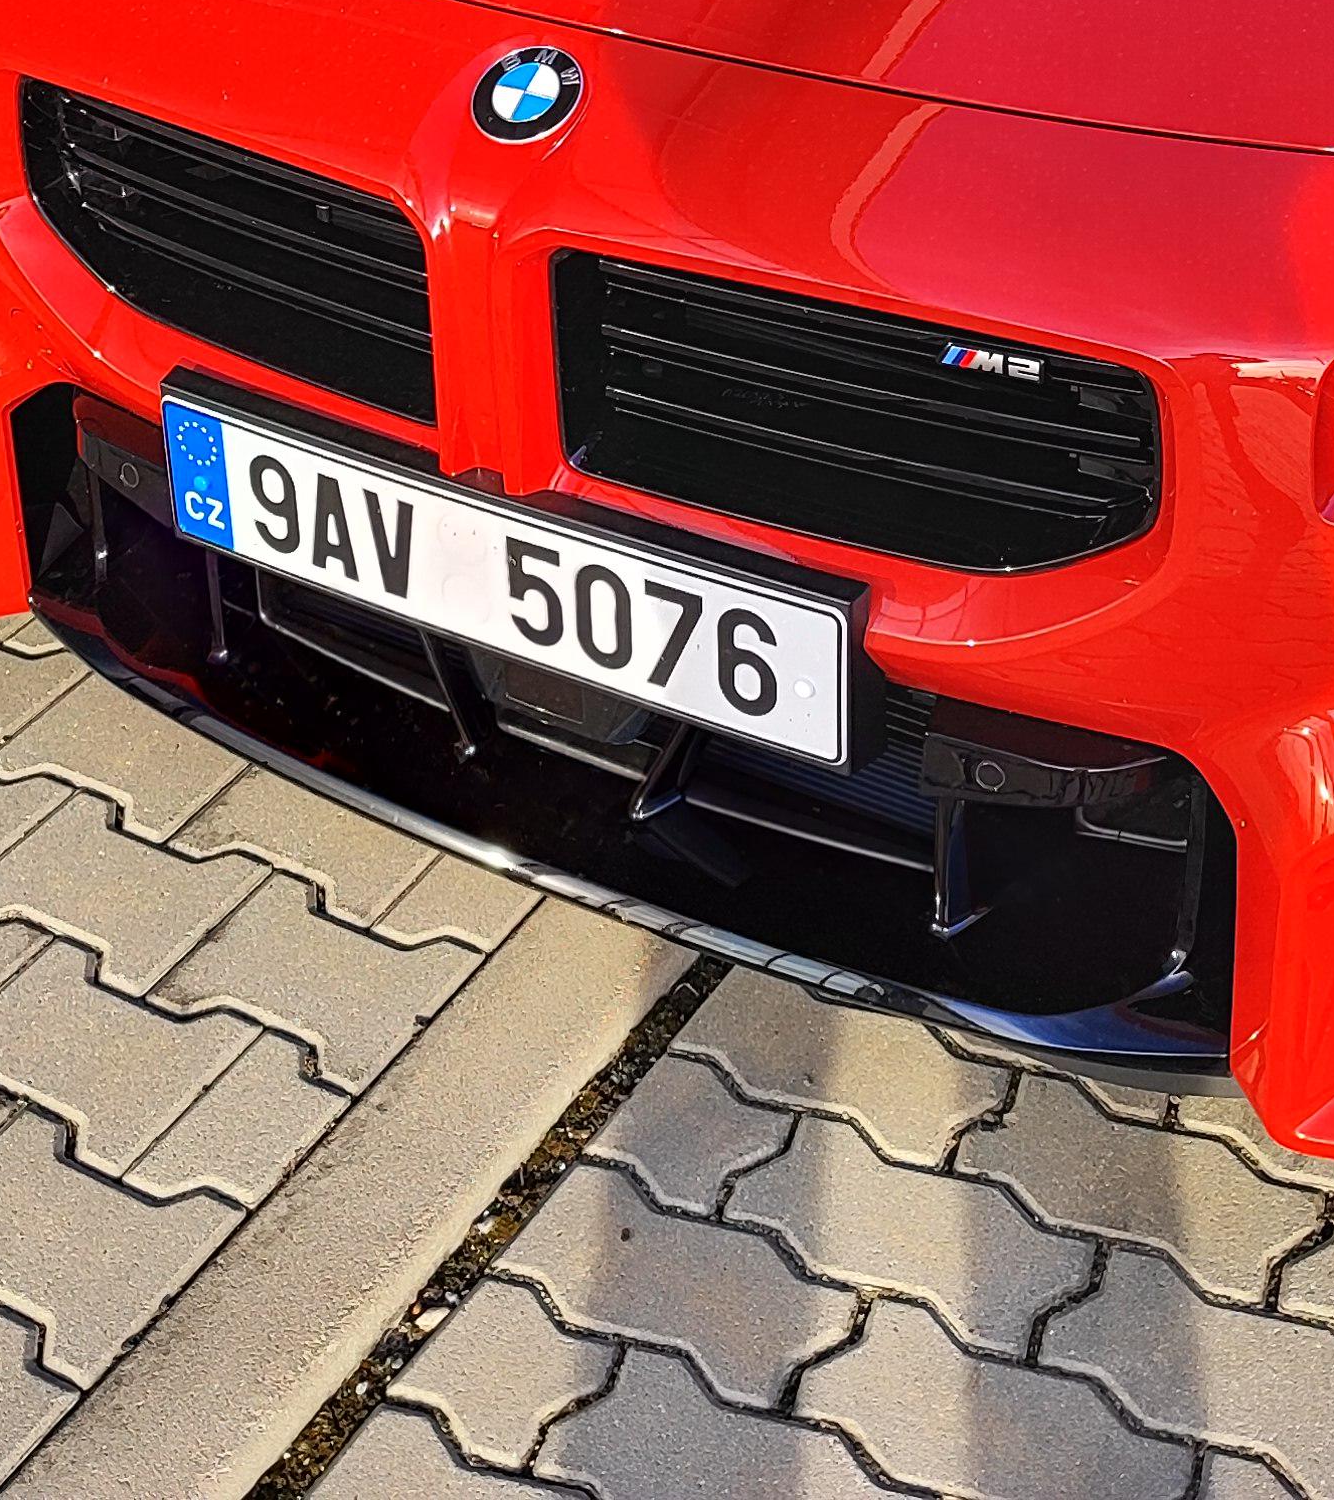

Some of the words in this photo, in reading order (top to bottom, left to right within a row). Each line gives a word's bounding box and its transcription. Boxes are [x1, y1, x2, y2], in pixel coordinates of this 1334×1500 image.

[500, 48, 581, 86] BMW
[963, 349, 1041, 382] M2
[184, 490, 226, 531] CZ
[249, 454, 414, 599] 9AV
[505, 535, 779, 717] 5076
